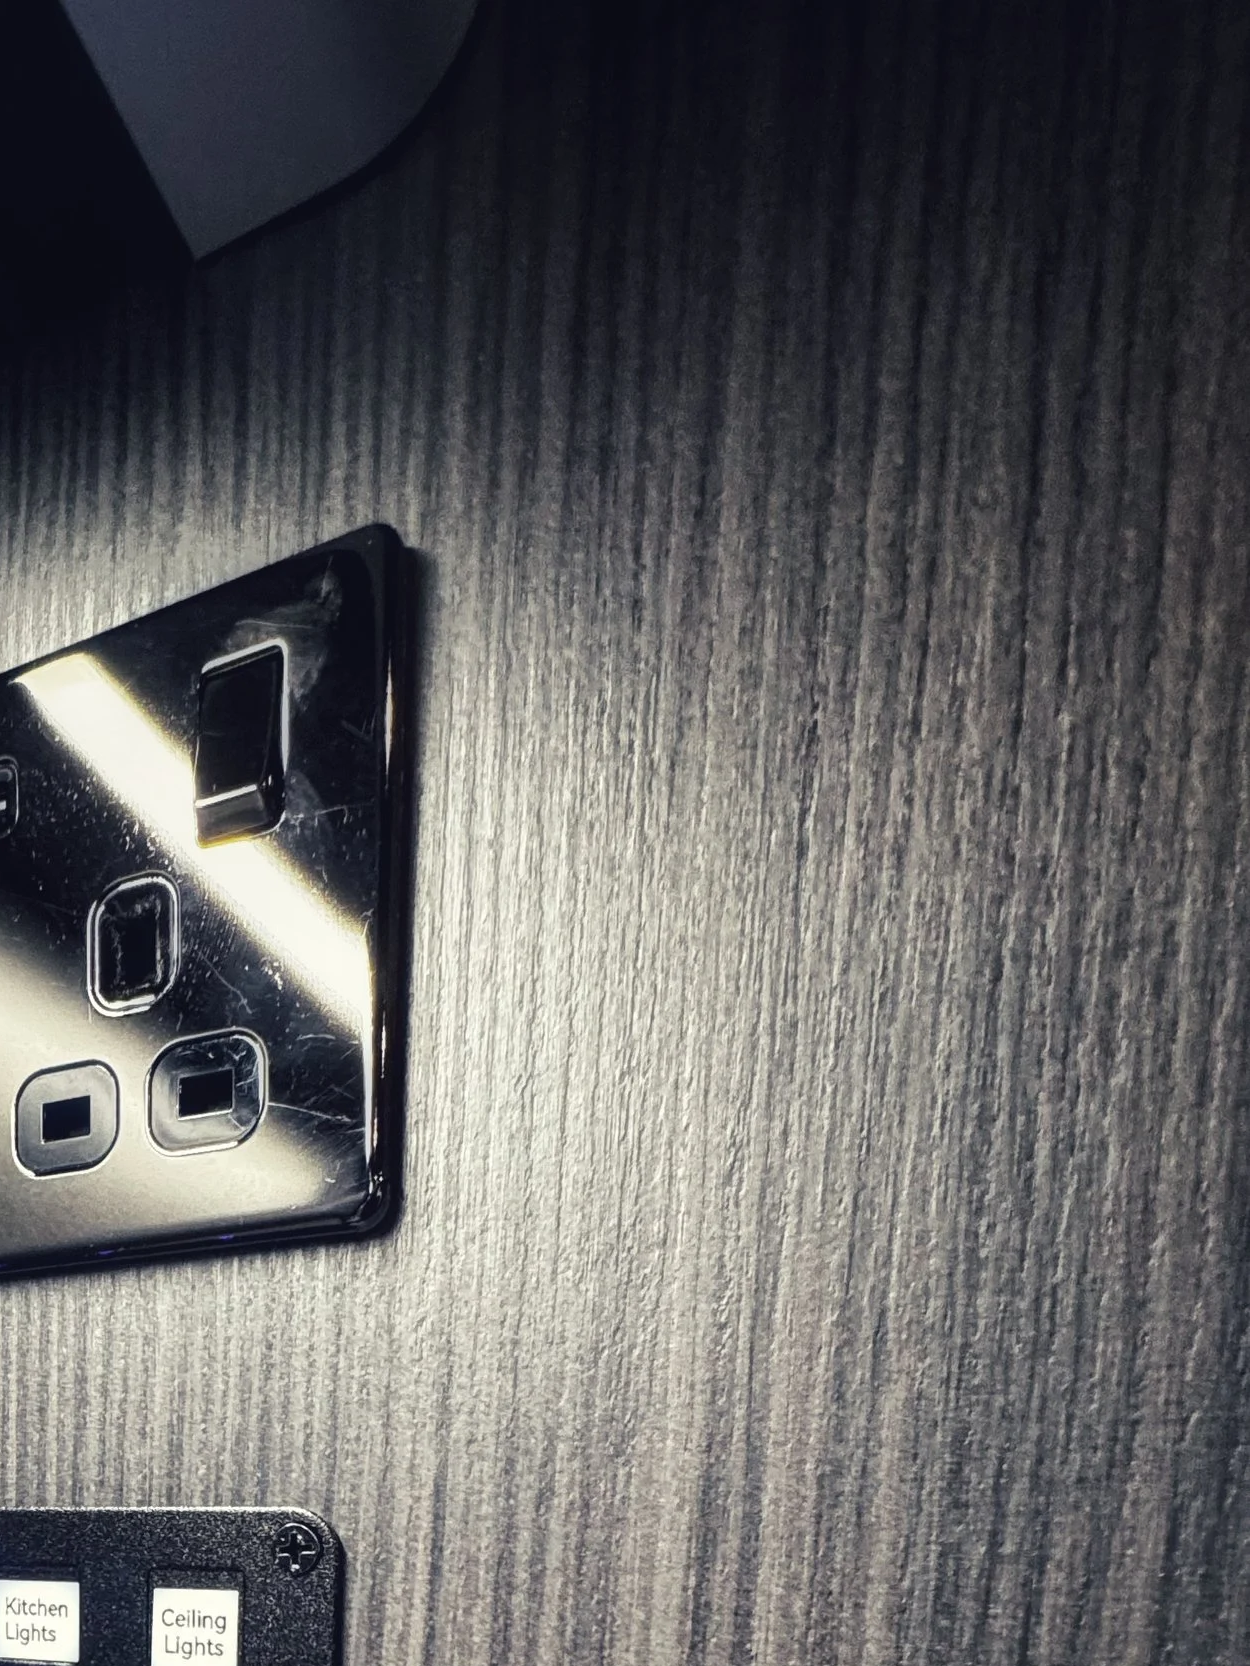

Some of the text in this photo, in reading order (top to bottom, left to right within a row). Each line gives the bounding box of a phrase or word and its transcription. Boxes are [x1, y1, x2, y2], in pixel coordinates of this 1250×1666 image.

[5, 1596, 69, 1619] Kitchen
[5, 1622, 56, 1646] Lights
[161, 1608, 227, 1635] Ceiling
[164, 1634, 224, 1660] Lights
